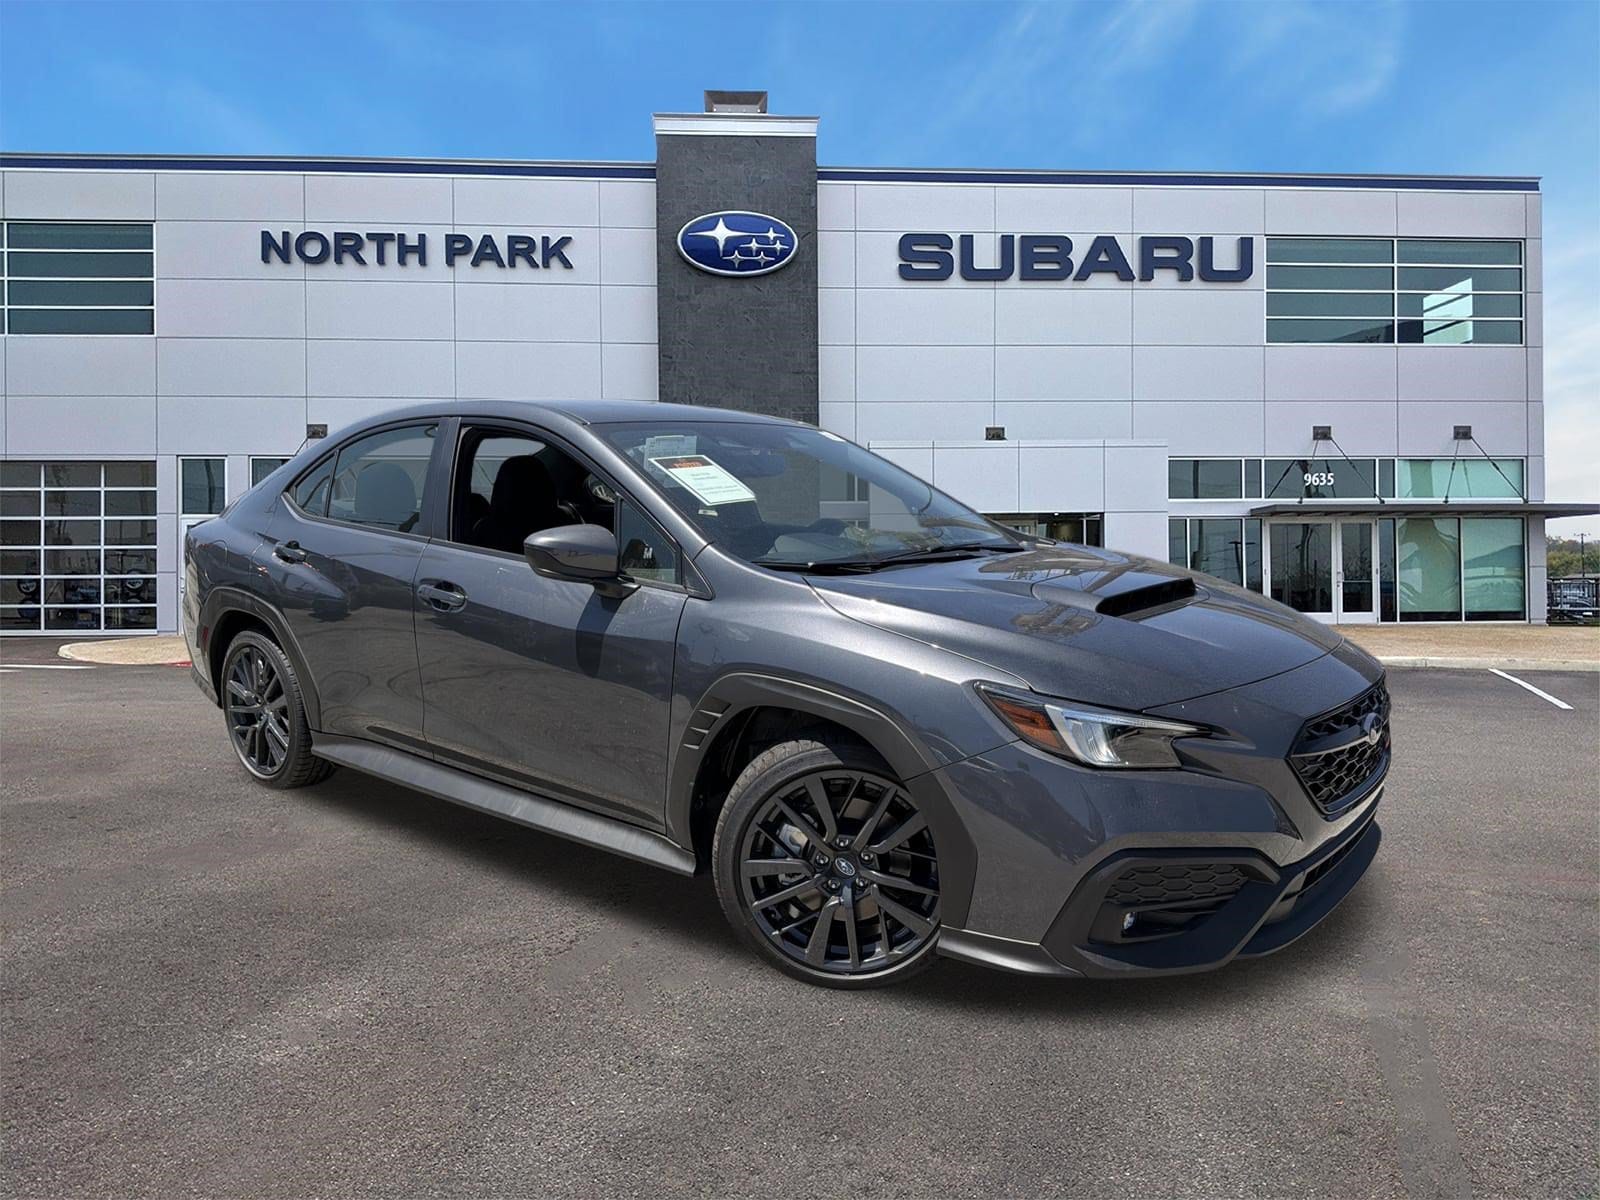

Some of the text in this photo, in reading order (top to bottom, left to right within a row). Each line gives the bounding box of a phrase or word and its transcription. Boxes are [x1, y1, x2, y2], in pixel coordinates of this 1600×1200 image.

[261, 230, 574, 269] NORTH PARK
[898, 233, 1254, 282] SUBARU
[1303, 472, 1335, 486] 9635
